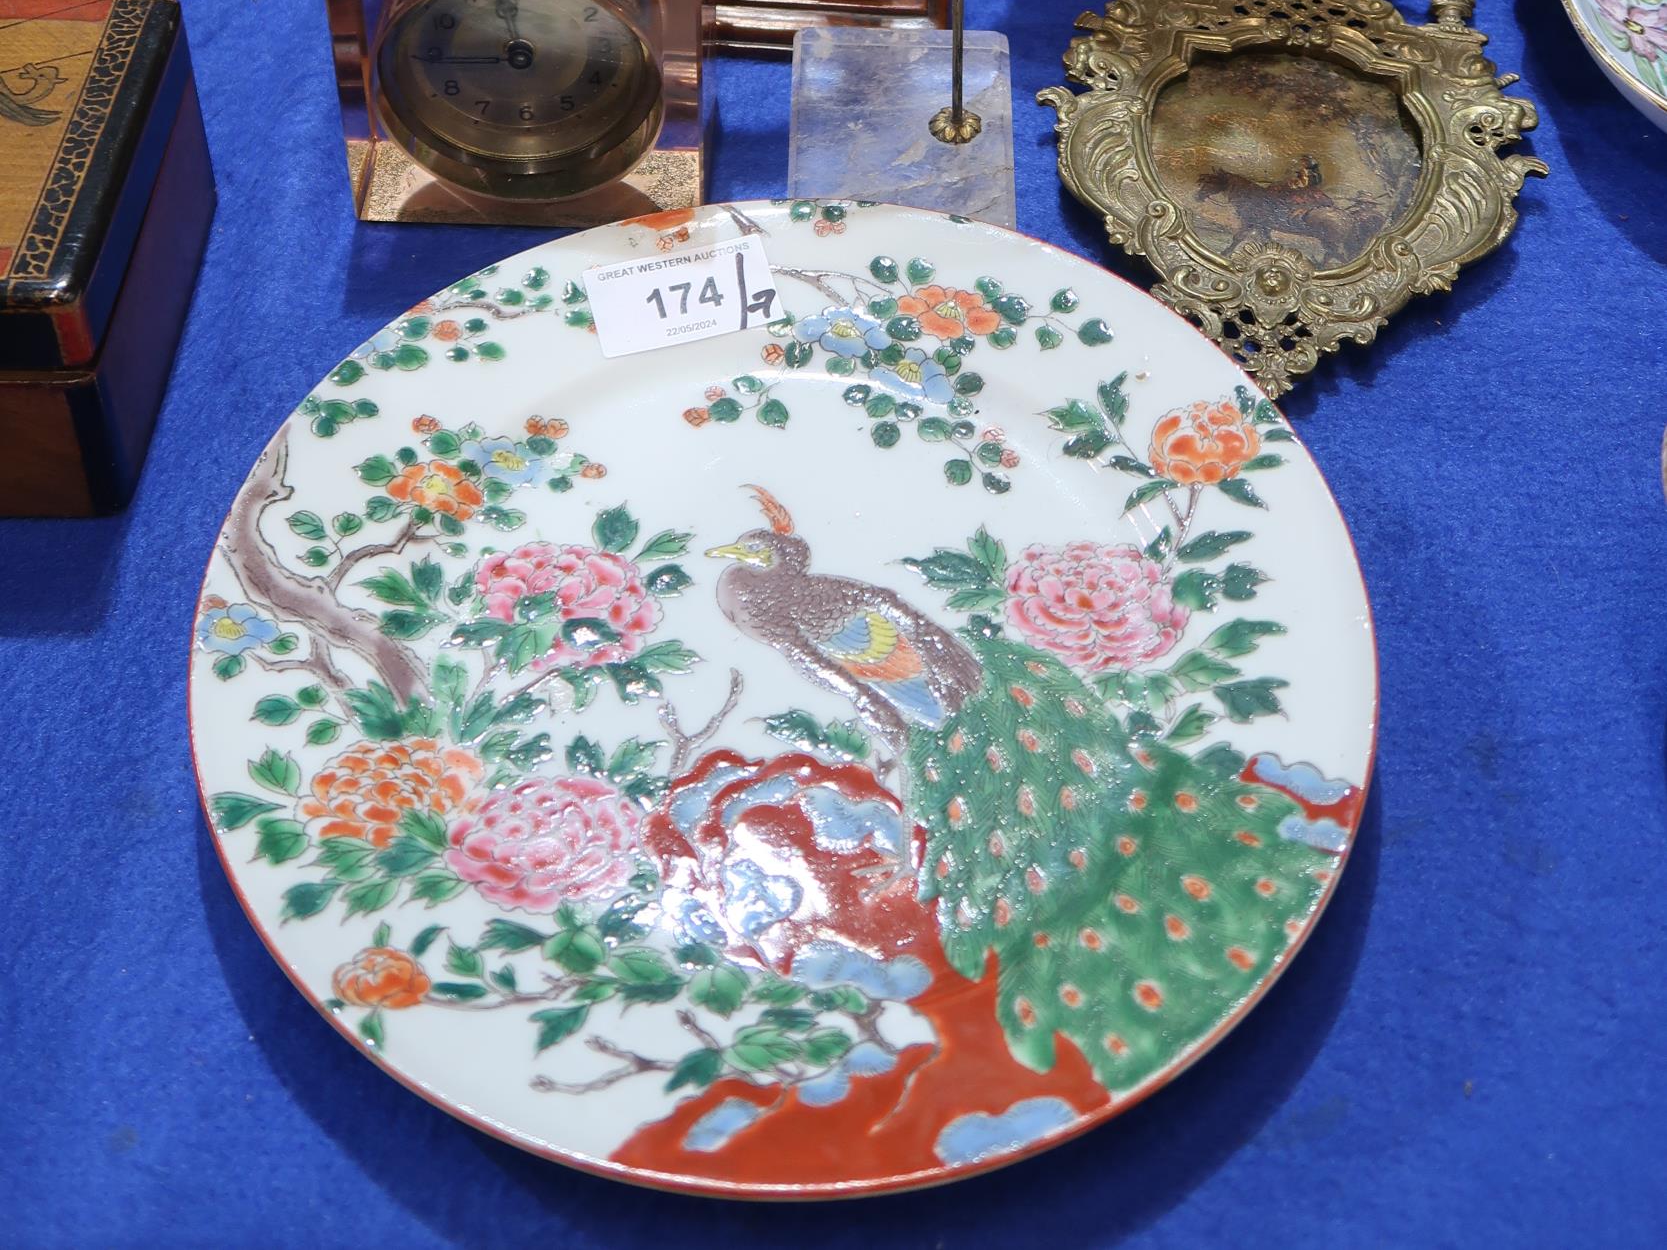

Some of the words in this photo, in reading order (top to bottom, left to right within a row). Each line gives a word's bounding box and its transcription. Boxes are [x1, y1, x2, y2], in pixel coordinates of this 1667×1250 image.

[433, 13, 456, 30] 10
[583, 6, 599, 23] 2
[588, 70, 603, 86] 4
[444, 79, 461, 96] 8
[475, 100, 491, 116] 7
[560, 95, 576, 111] 5
[519, 105, 534, 122] 6
[597, 266, 635, 282] GREAT
[636, 255, 692, 273] WESTERN
[694, 241, 750, 262] AUCTIONS
[665, 319, 718, 337] 22/05/2024
